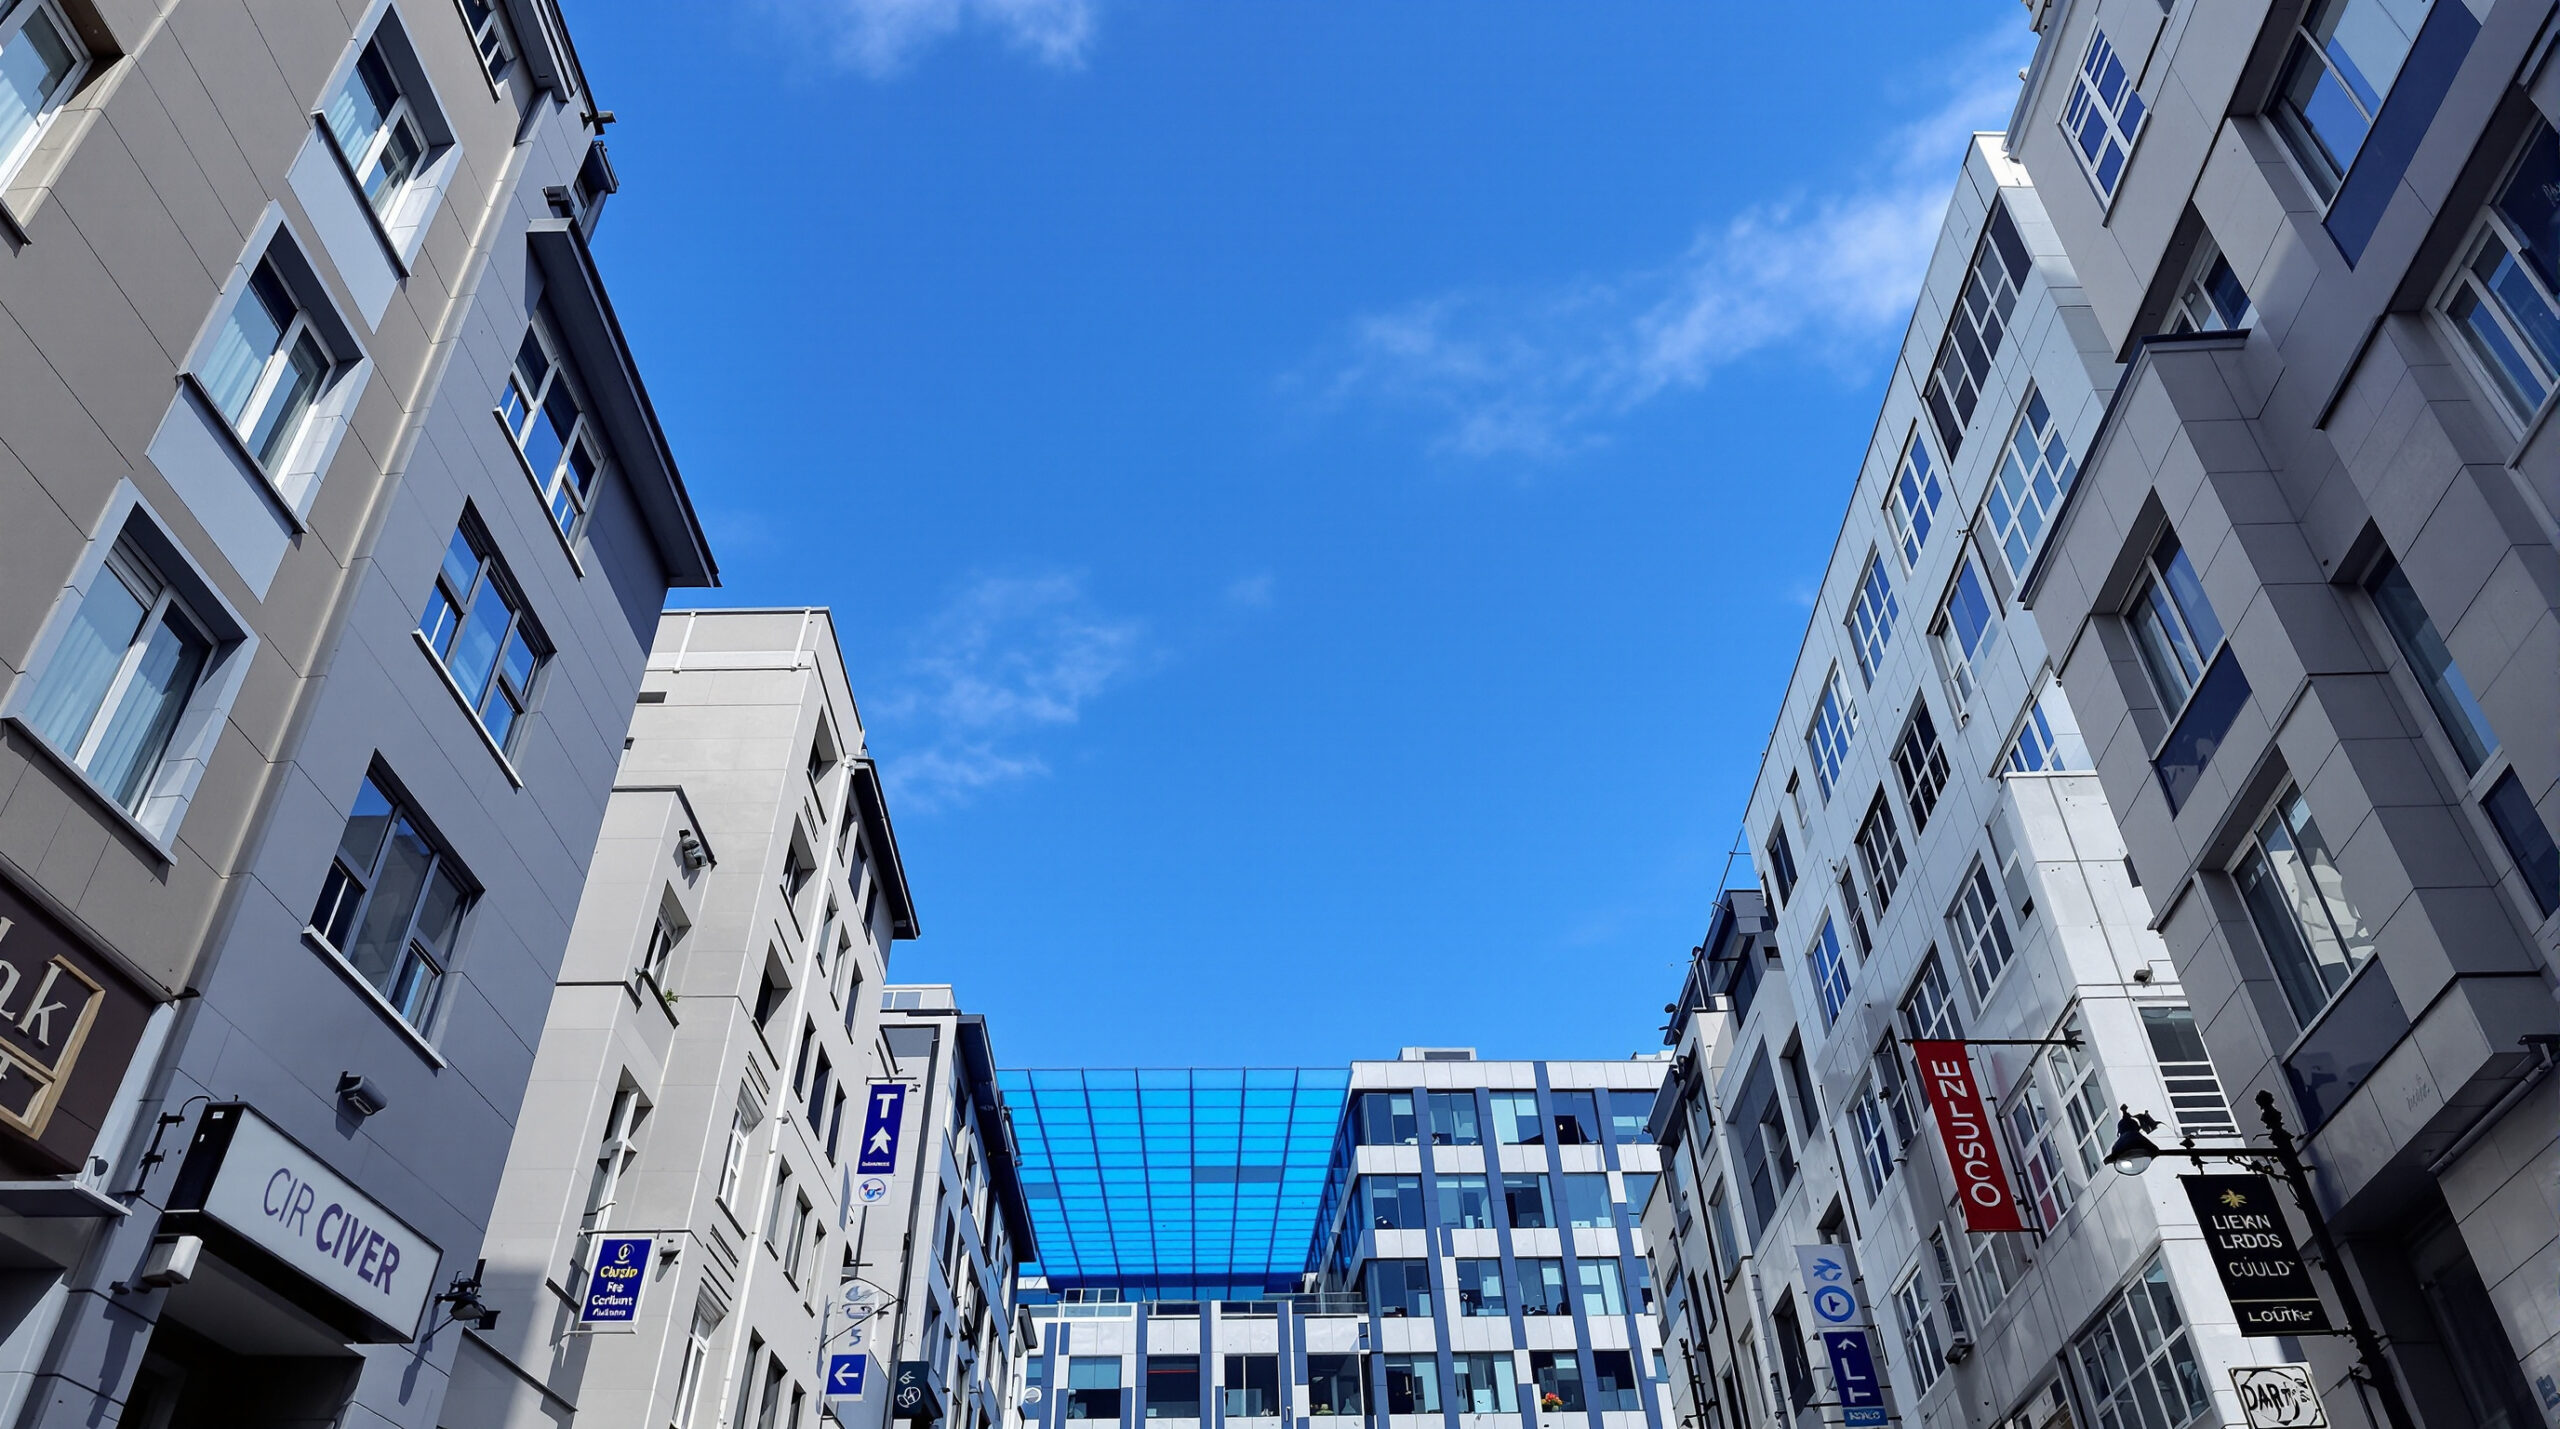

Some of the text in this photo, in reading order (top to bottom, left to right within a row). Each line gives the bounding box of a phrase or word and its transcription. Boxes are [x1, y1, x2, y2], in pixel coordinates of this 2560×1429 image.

[876, 1093, 898, 1118] T
[263, 1168, 400, 1296] CIR CIVER
